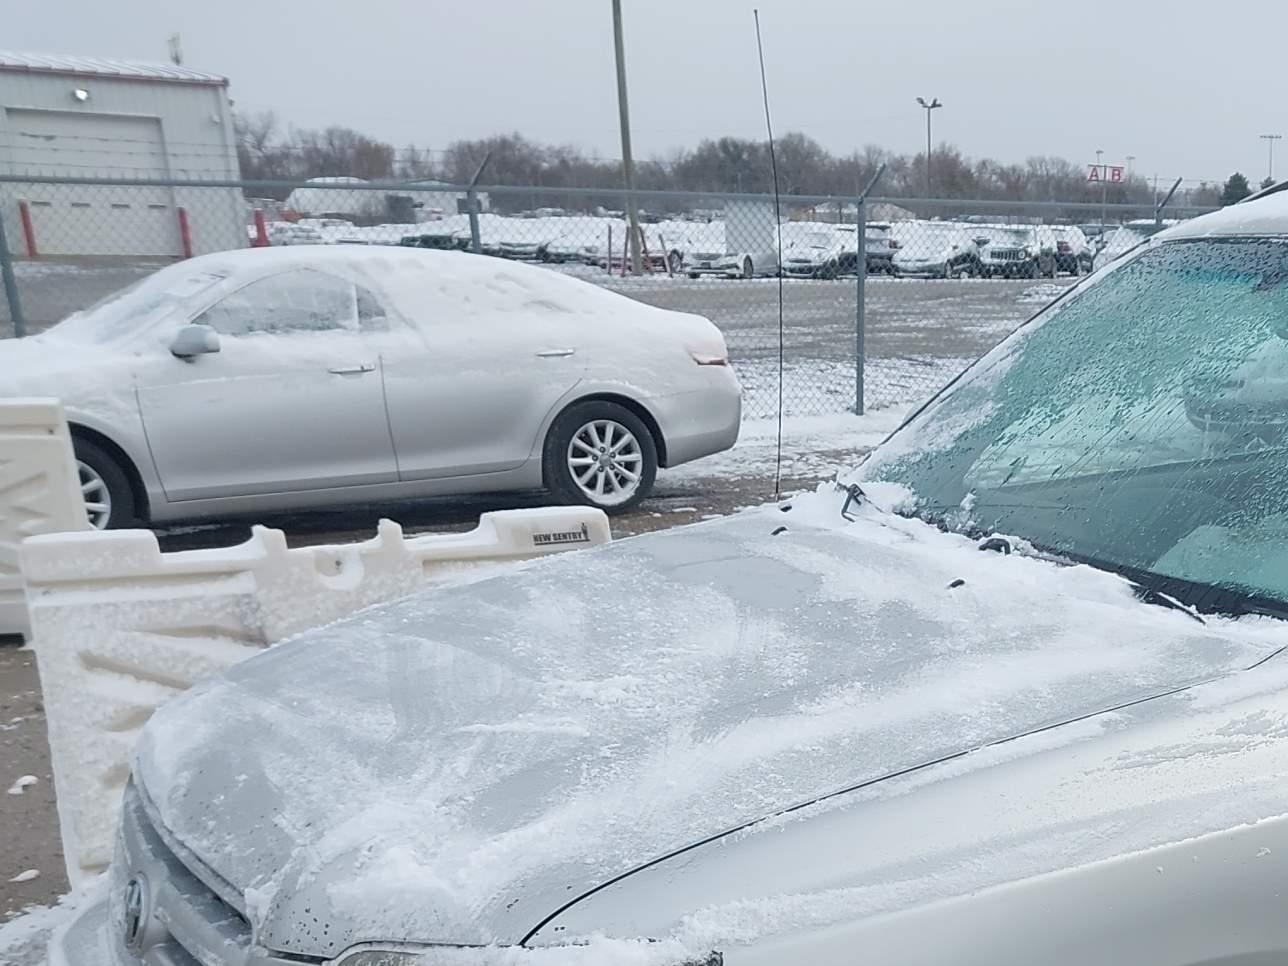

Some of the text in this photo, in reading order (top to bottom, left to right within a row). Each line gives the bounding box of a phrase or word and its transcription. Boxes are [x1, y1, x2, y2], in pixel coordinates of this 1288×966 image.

[1088, 166, 1100, 182] A
[1111, 168, 1121, 182] B
[533, 531, 582, 542] NEW SENTRY
